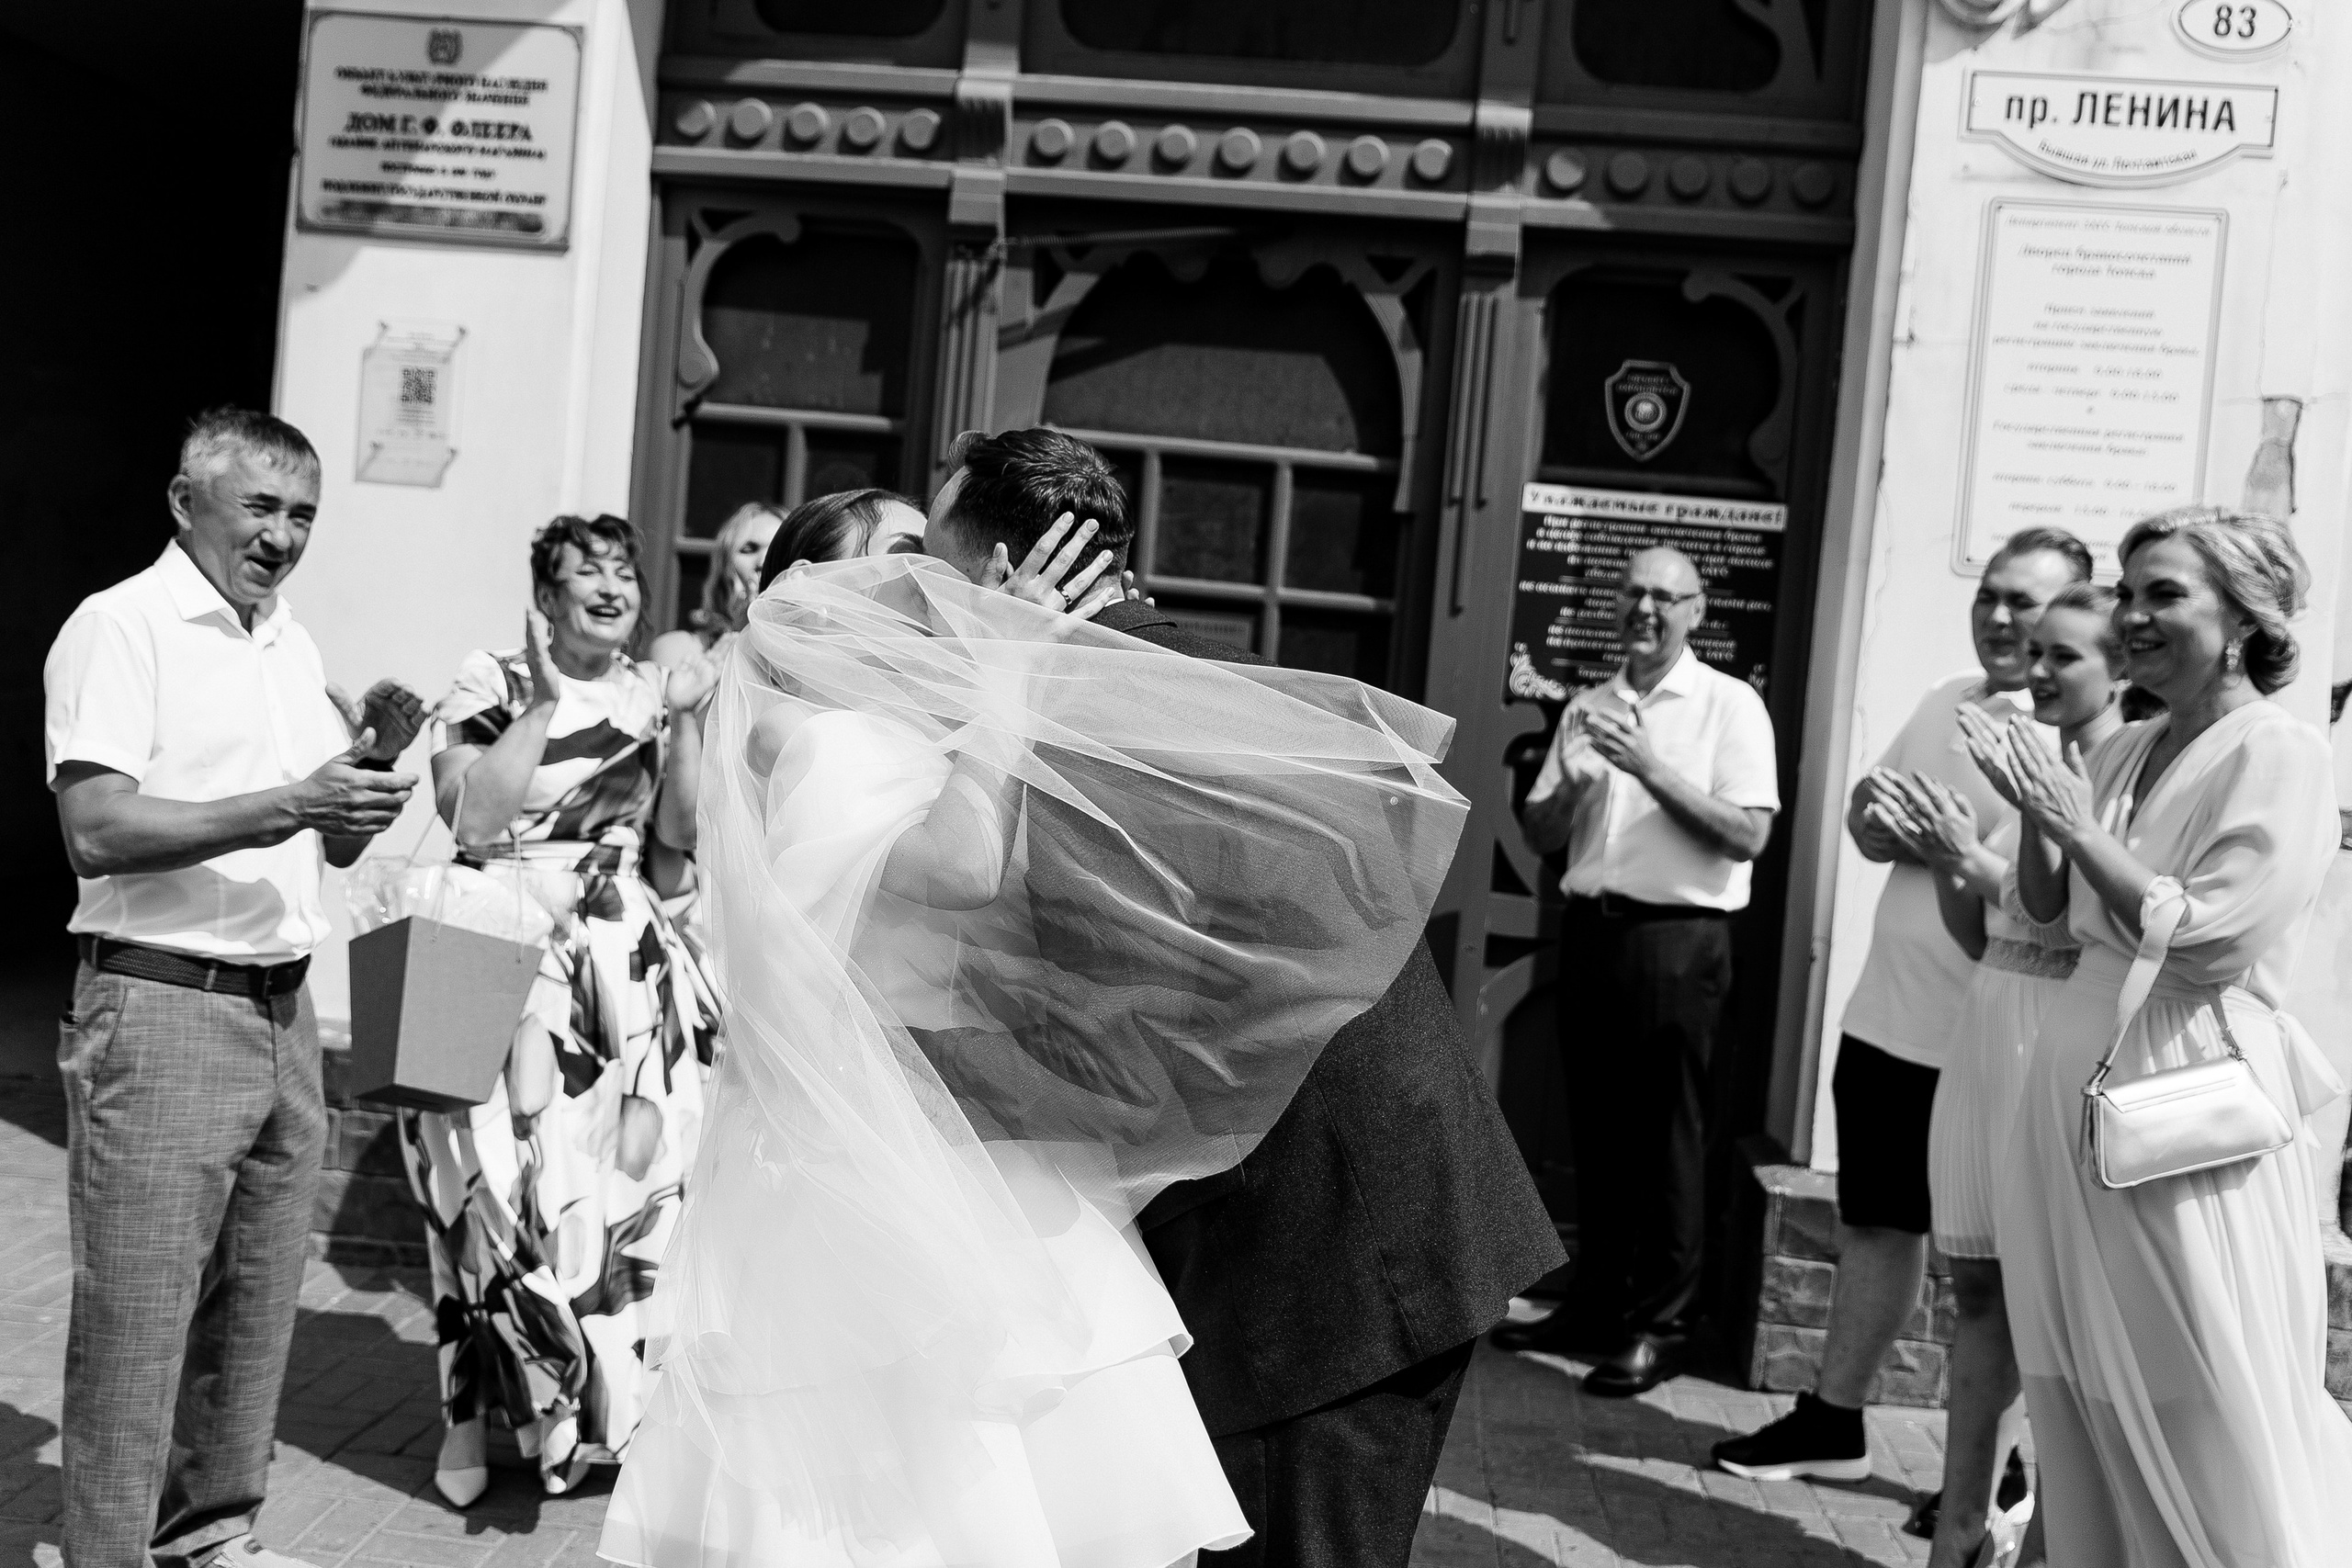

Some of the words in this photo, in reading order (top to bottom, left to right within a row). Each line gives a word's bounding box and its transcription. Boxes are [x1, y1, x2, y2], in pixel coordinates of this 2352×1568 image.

[2212, 4, 2256, 39] 83
[344, 111, 397, 133] ДОМ
[2005, 95, 2058, 130] пр.
[2072, 91, 2237, 132] ЛЕНИНА
[1530, 490, 1660, 514] Уважаемые
